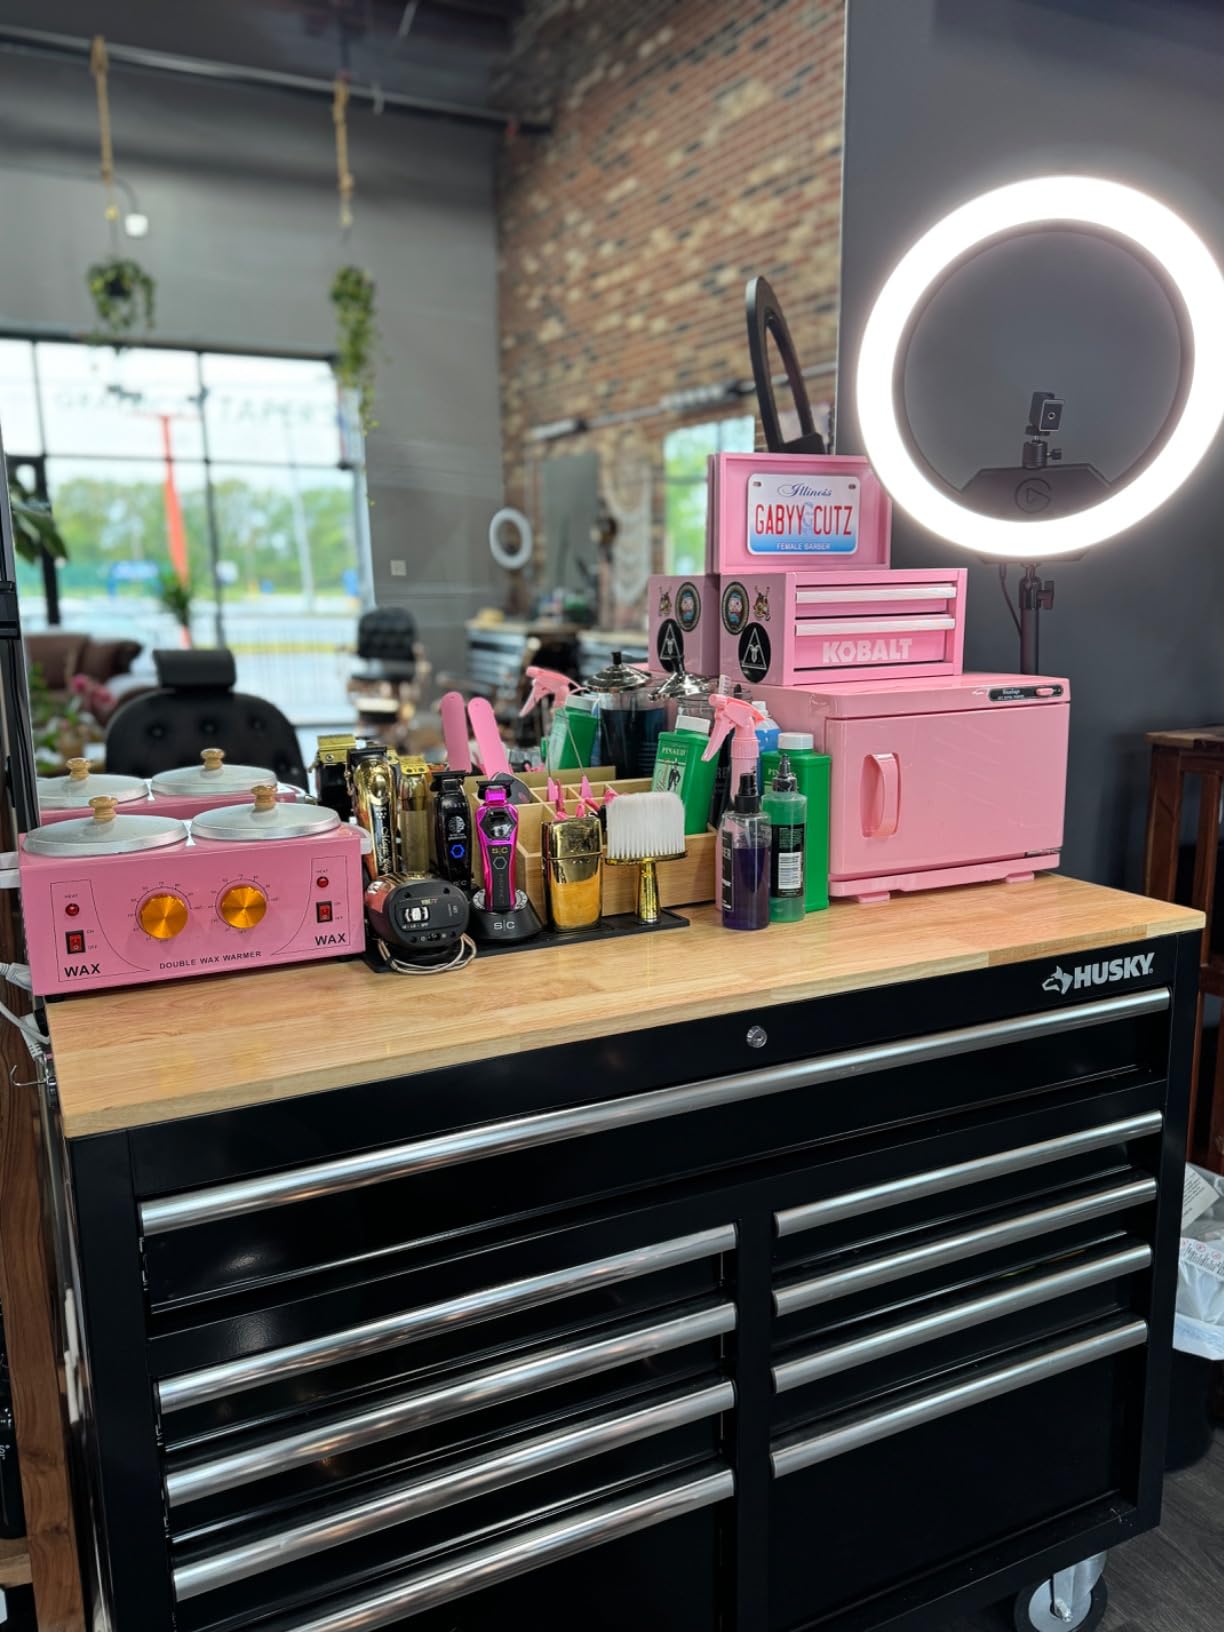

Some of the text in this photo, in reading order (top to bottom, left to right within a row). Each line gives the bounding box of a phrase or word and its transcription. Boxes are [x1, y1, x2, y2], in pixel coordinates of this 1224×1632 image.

[777, 483, 832, 497] Illinois
[755, 504, 853, 536] GABYY CUTZ
[776, 543, 831, 551] FEMALE BARBER
[822, 638, 913, 665] KOBALT
[314, 933, 346, 946] WAX
[159, 950, 262, 969] DOUBLE WAX WARMER
[64, 963, 101, 977] WAX
[1073, 952, 1155, 989] HUSKY
